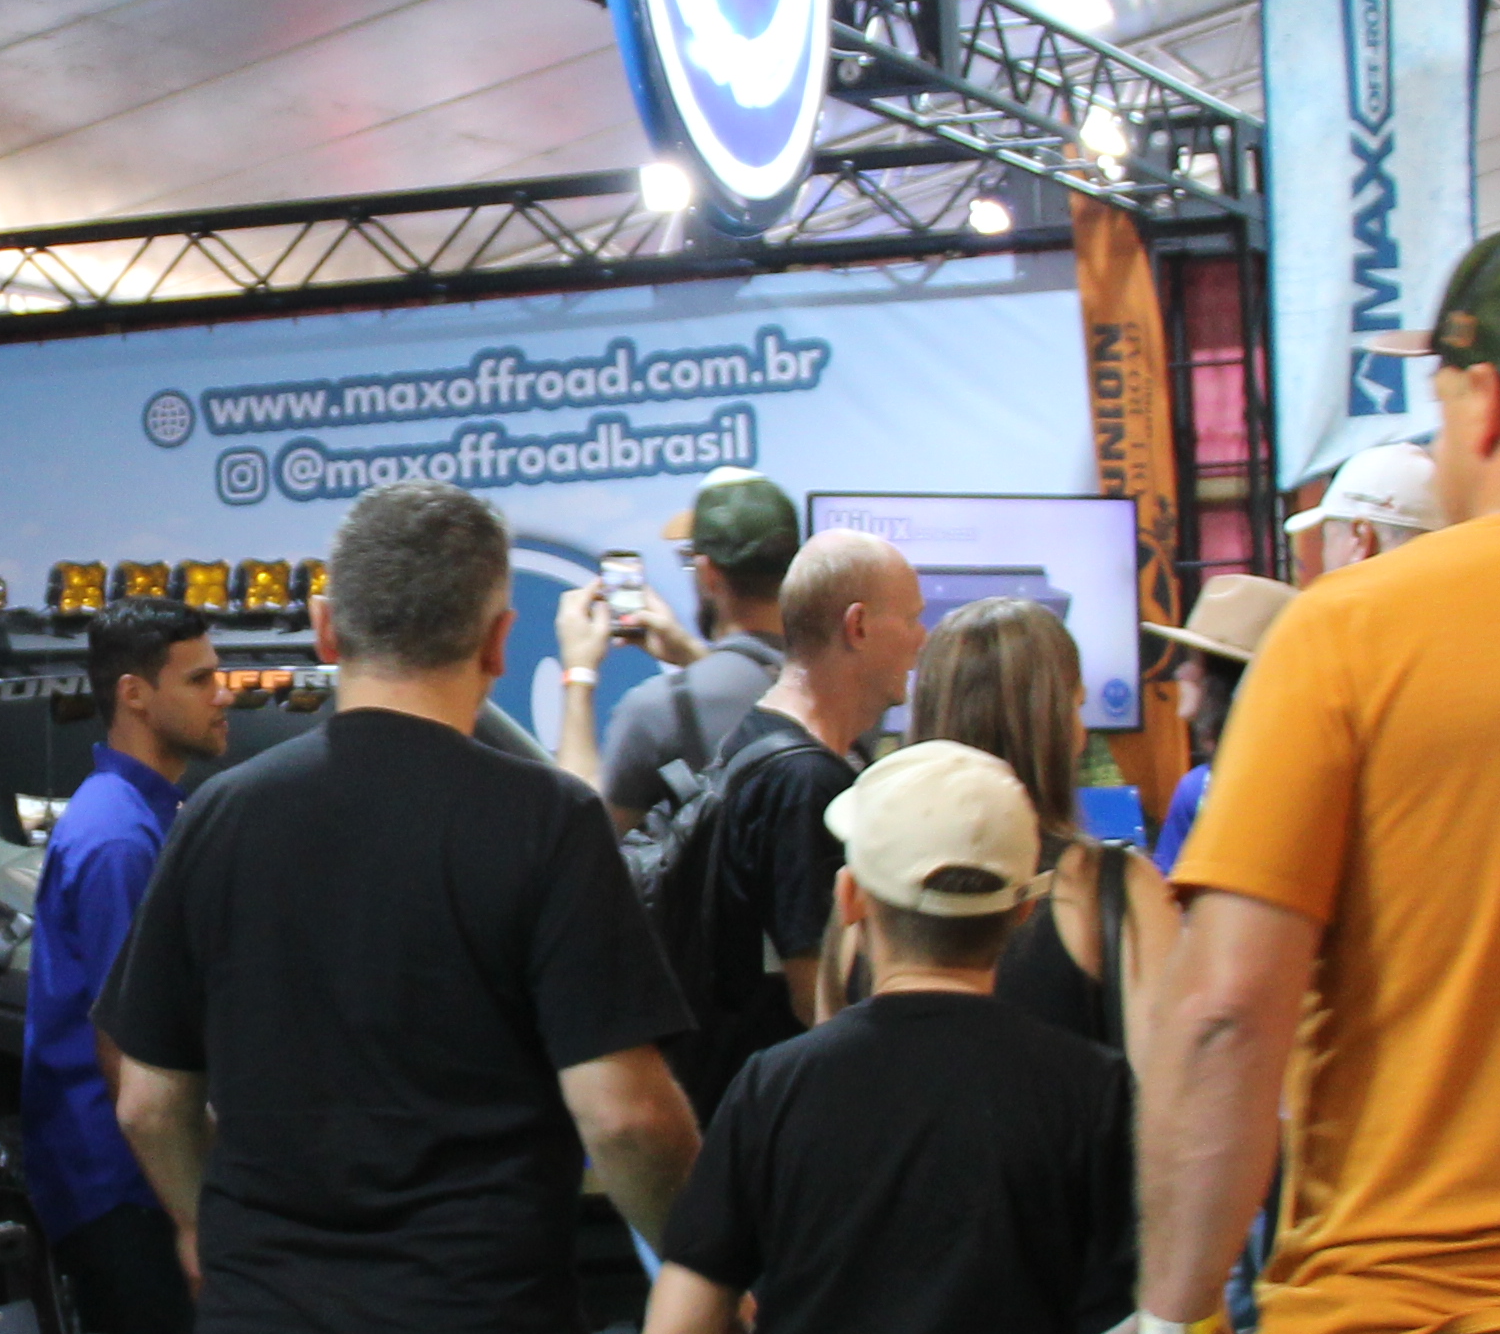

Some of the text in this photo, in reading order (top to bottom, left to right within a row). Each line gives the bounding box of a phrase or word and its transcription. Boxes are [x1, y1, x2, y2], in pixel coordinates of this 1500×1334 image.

[1351, 130, 1401, 332] MAX
[209, 336, 821, 428] www.maxoffroad.com.br
[283, 415, 750, 491] @maxoffroadbrasil
